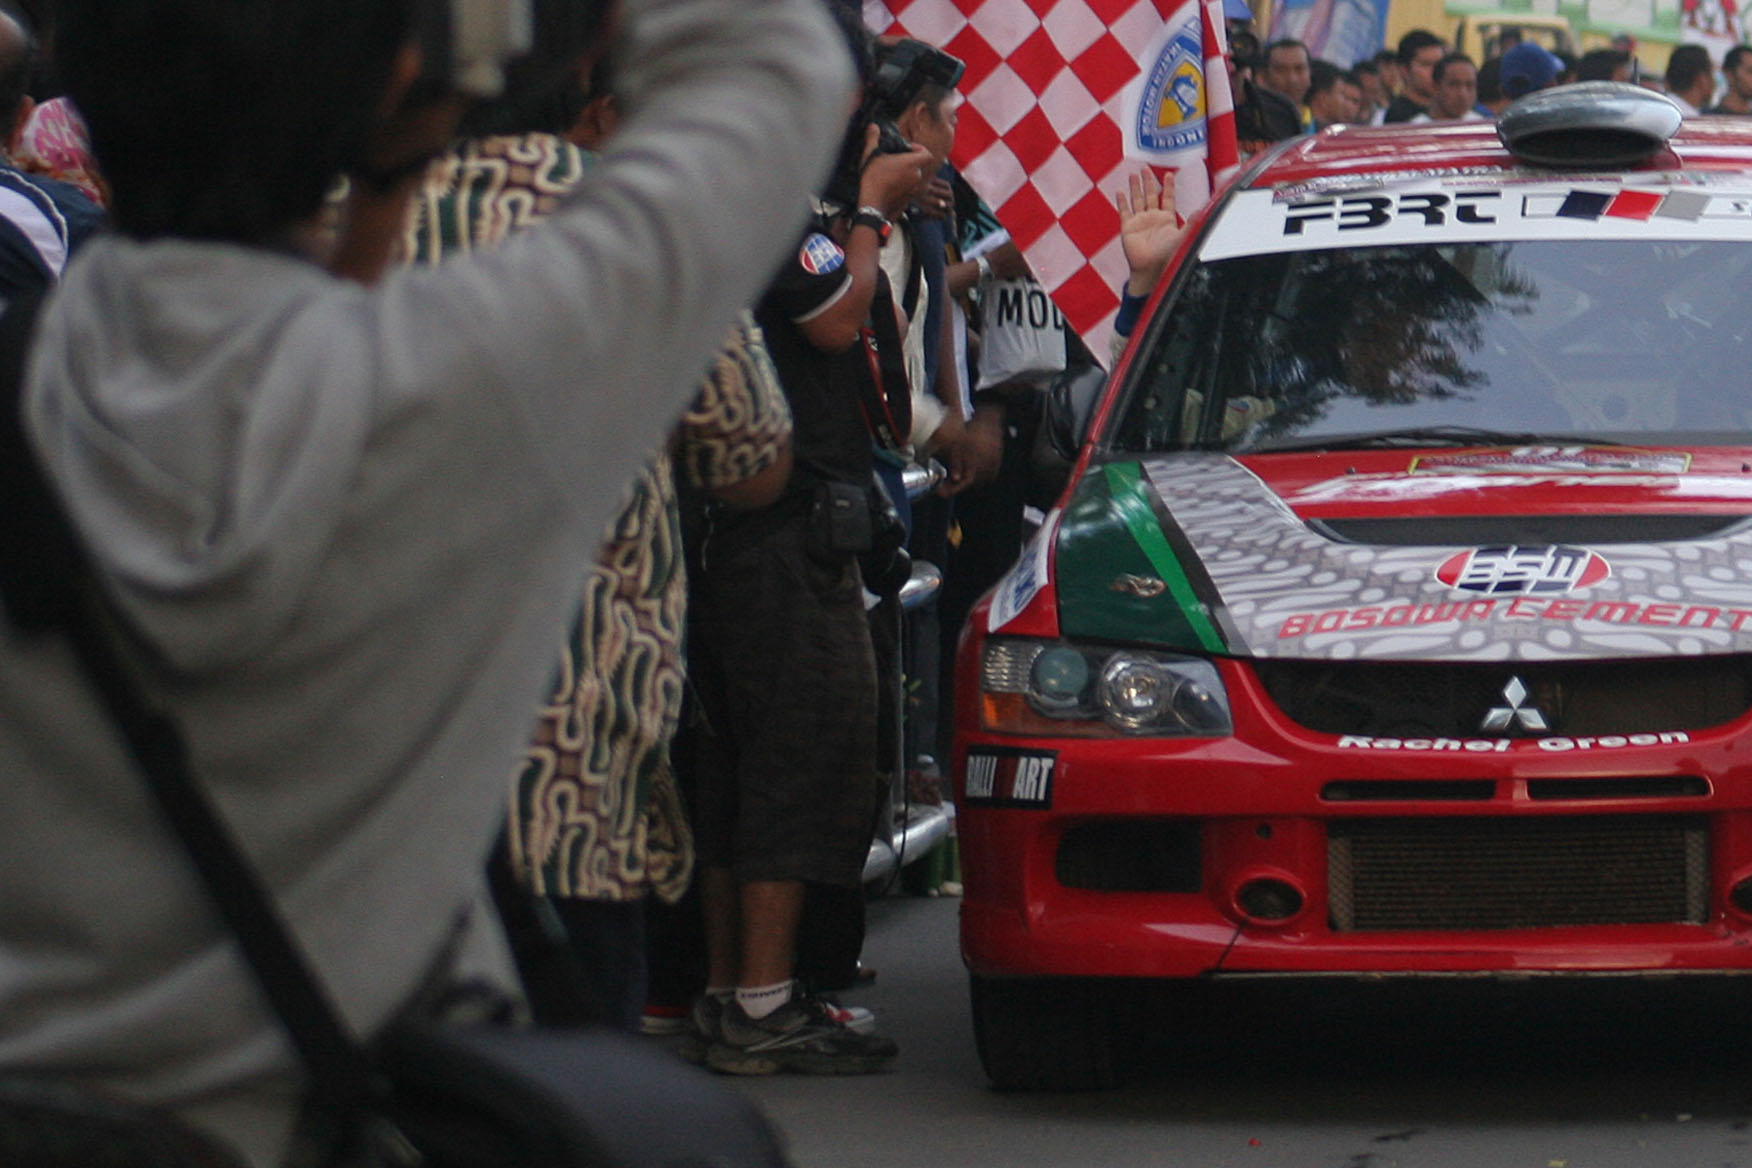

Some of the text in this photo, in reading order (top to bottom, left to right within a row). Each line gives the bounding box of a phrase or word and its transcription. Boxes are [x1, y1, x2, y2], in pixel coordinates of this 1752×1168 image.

[1277, 597, 1497, 640] BOSOWA
[1338, 730, 1690, 753] Rachel Green
[965, 754, 1055, 801] RALLI ART
